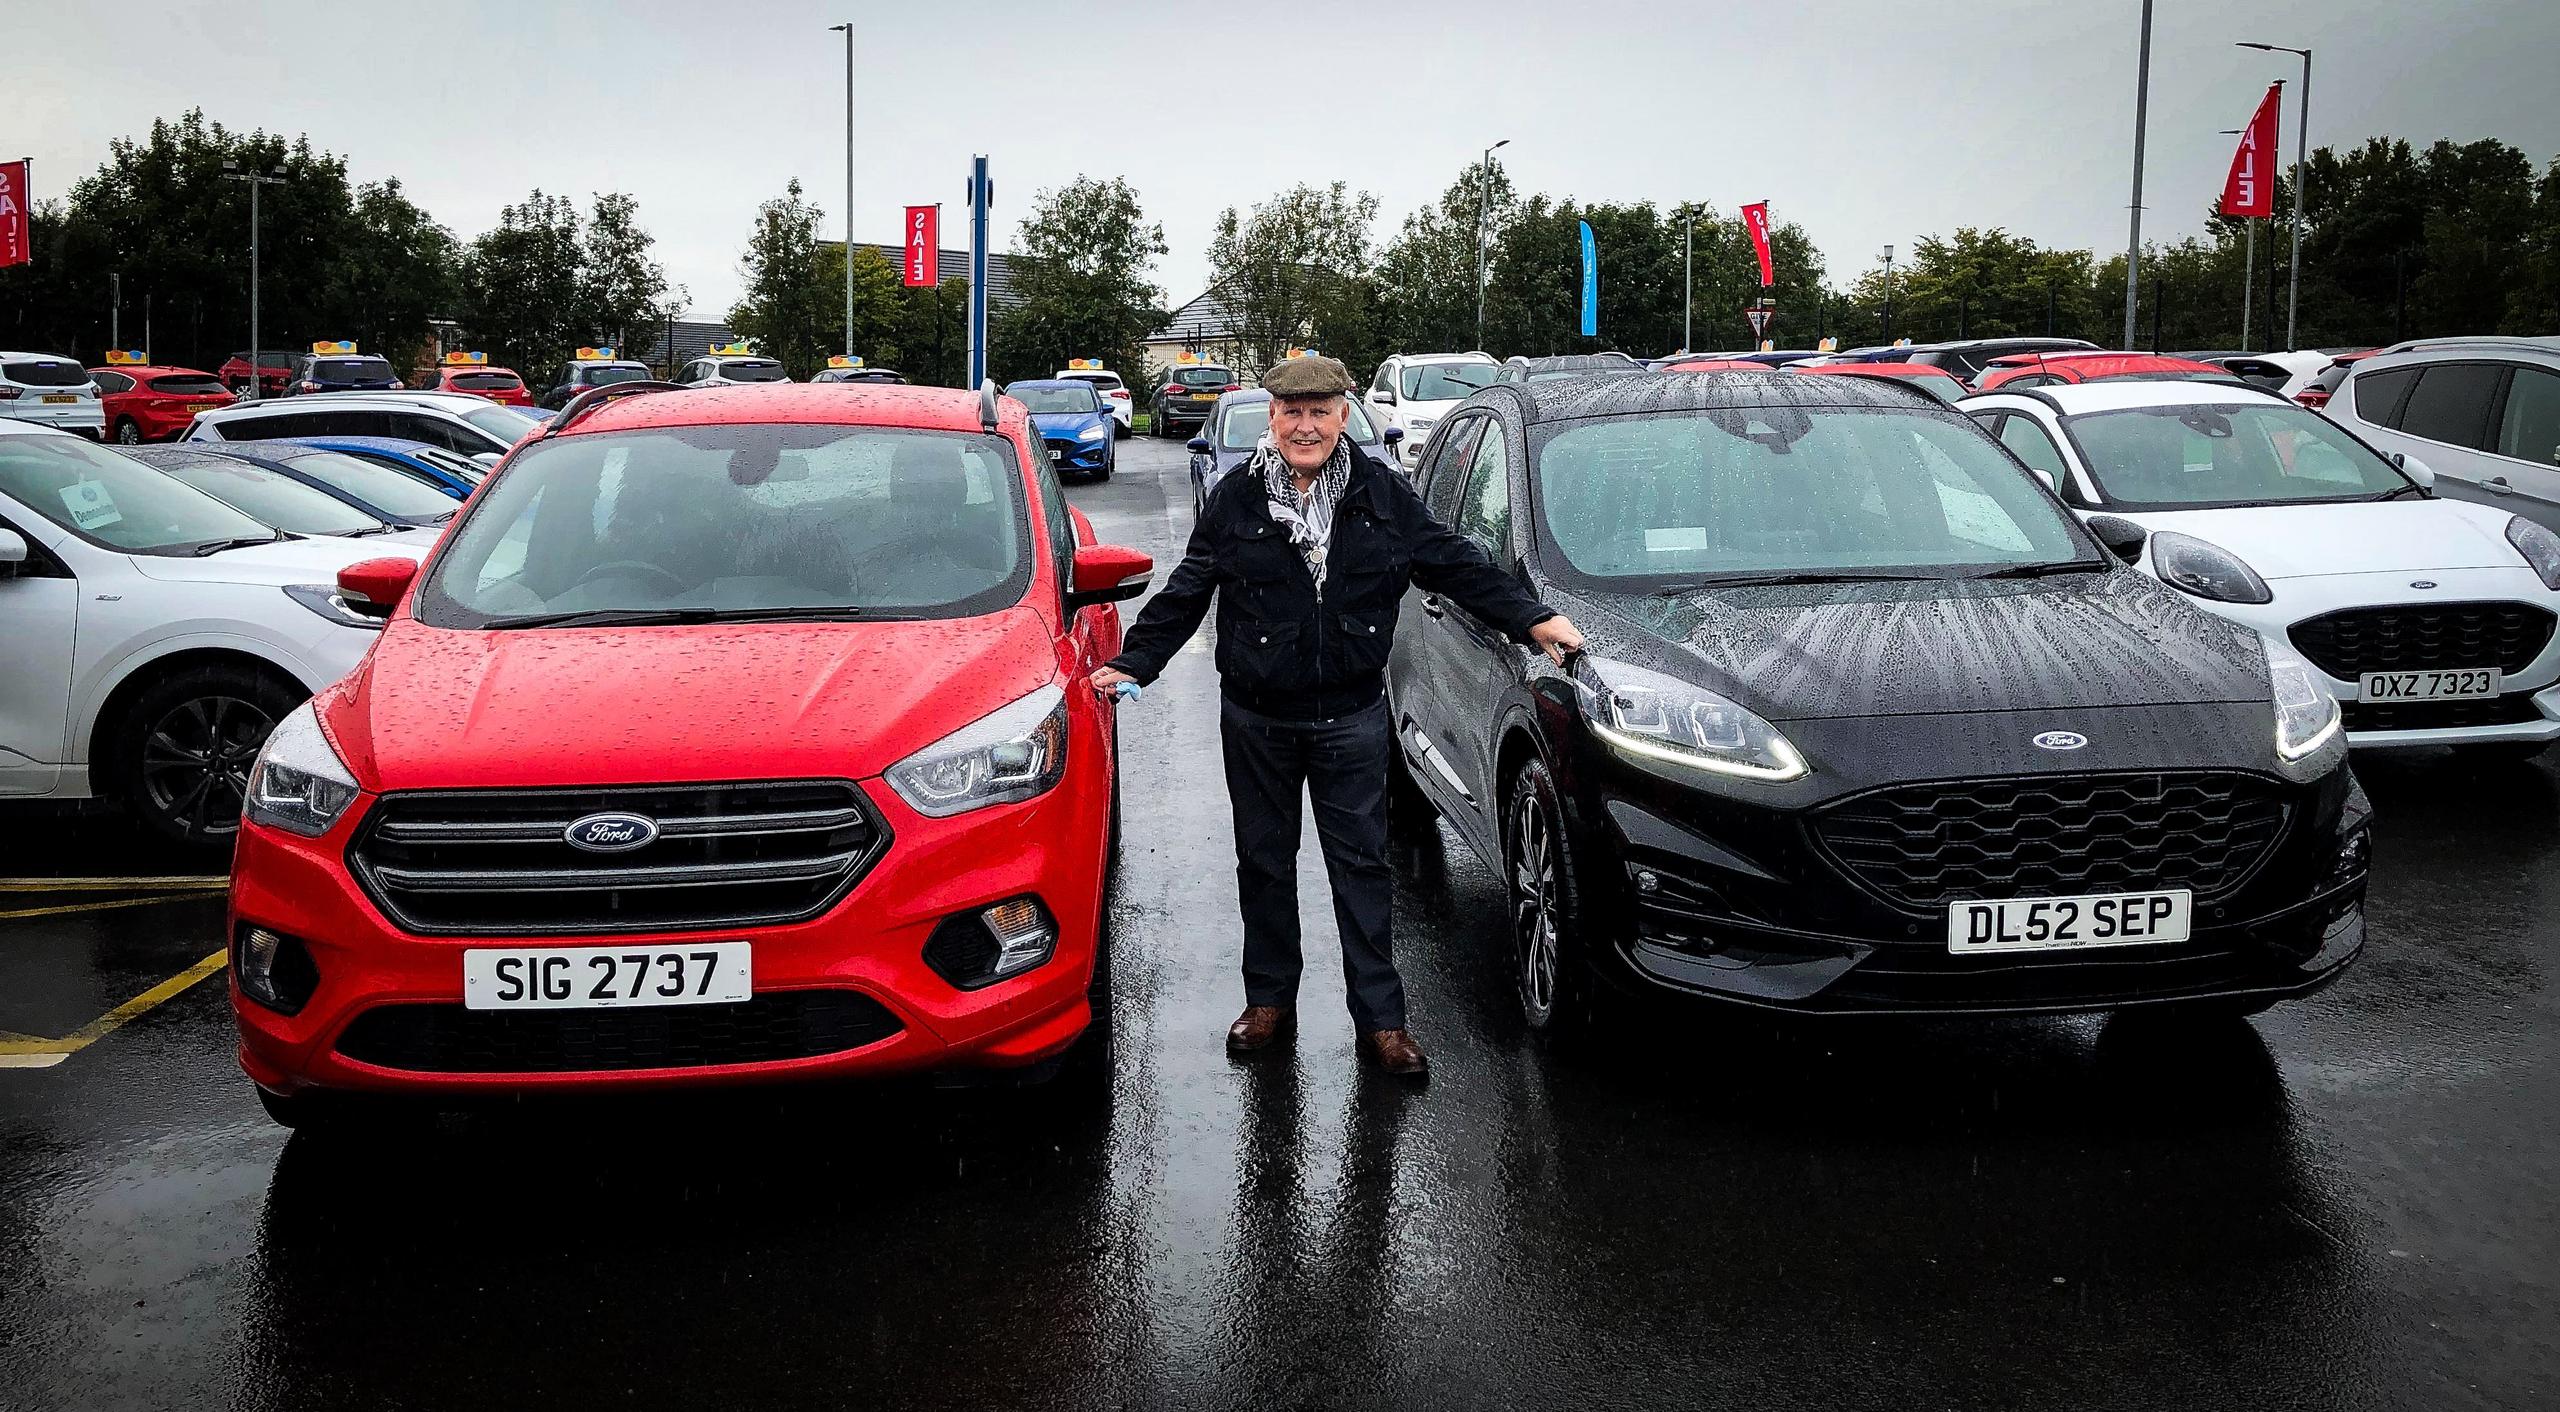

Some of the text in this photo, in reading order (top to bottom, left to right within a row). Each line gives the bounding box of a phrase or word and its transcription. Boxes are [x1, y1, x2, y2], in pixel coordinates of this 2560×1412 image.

[2370, 671, 2490, 697] OXZ 7323
[2046, 735, 2076, 746] Ford
[586, 822, 635, 842] Ford
[1967, 896, 2173, 944] DL52 SEP
[496, 951, 719, 1000] SIG 2737
